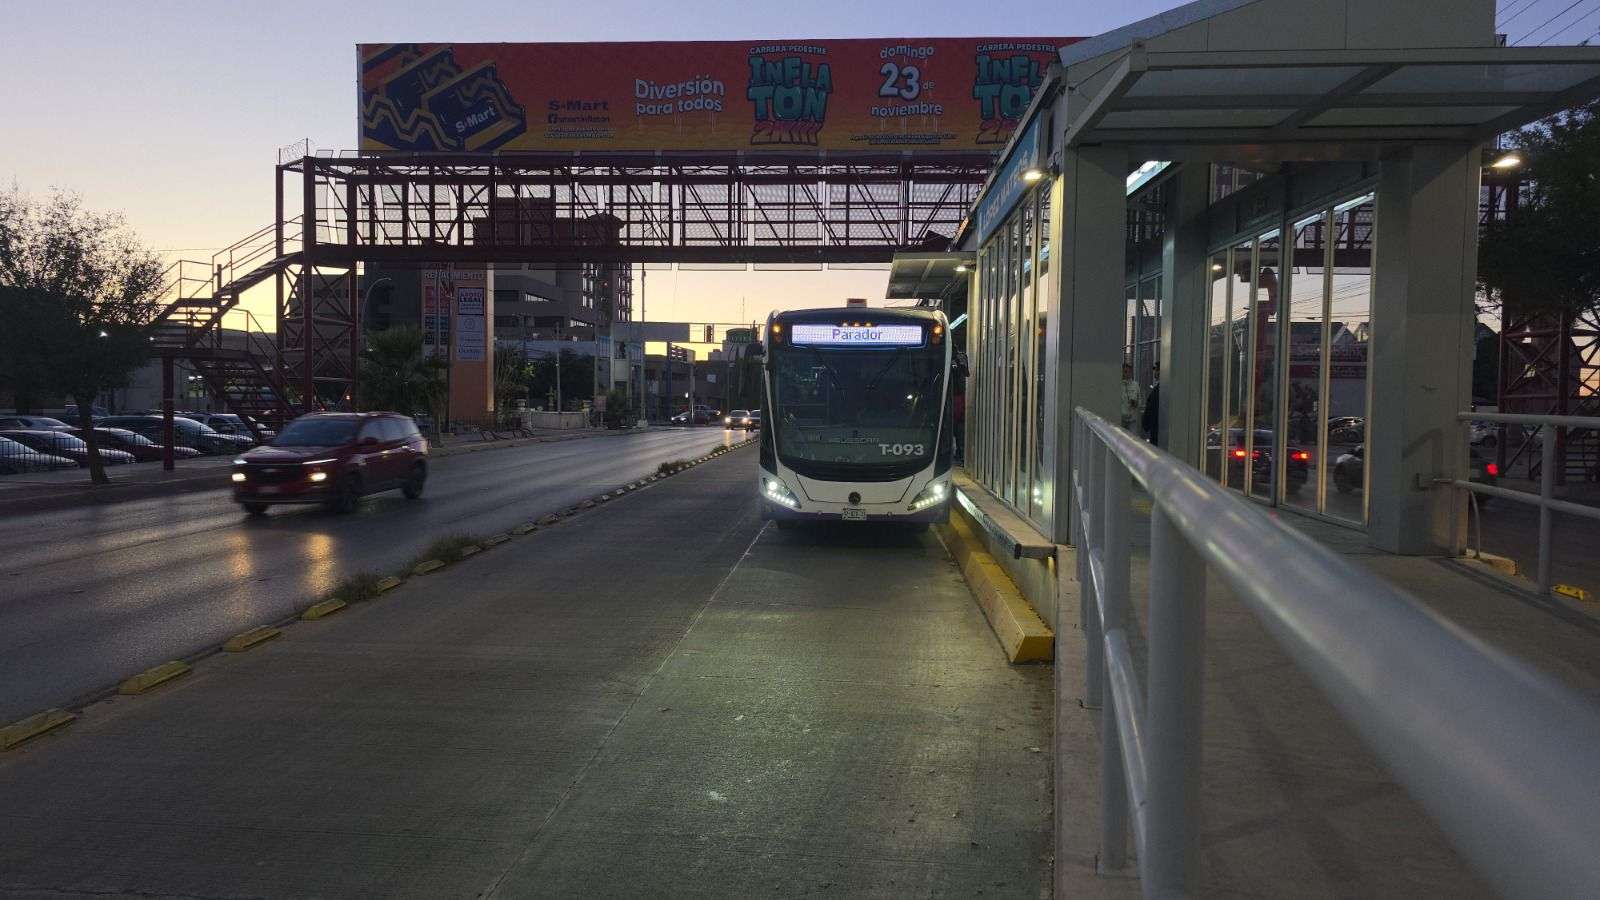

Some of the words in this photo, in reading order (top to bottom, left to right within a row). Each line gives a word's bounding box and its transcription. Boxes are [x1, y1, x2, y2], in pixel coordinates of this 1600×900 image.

[748, 45, 787, 55] CARRERA
[788, 45, 828, 55] PEDESTRE
[879, 45, 934, 60] domingo
[976, 43, 1014, 53] CARRERA
[1016, 43, 1056, 53] PEDESTRE
[748, 56, 833, 93] INFLA
[879, 62, 920, 100] 23
[922, 80, 935, 90] de
[975, 54, 1045, 87] INFL
[634, 74, 725, 99] Diversión
[548, 98, 609, 112] S-Mart
[636, 102, 674, 116] para
[678, 94, 723, 113] todos
[747, 81, 828, 122] TON
[871, 100, 945, 116] noviembre
[973, 81, 1033, 120] TO
[455, 105, 497, 134] S-Mart
[832, 328, 883, 341] Parador
[878, 443, 925, 456] T-093
